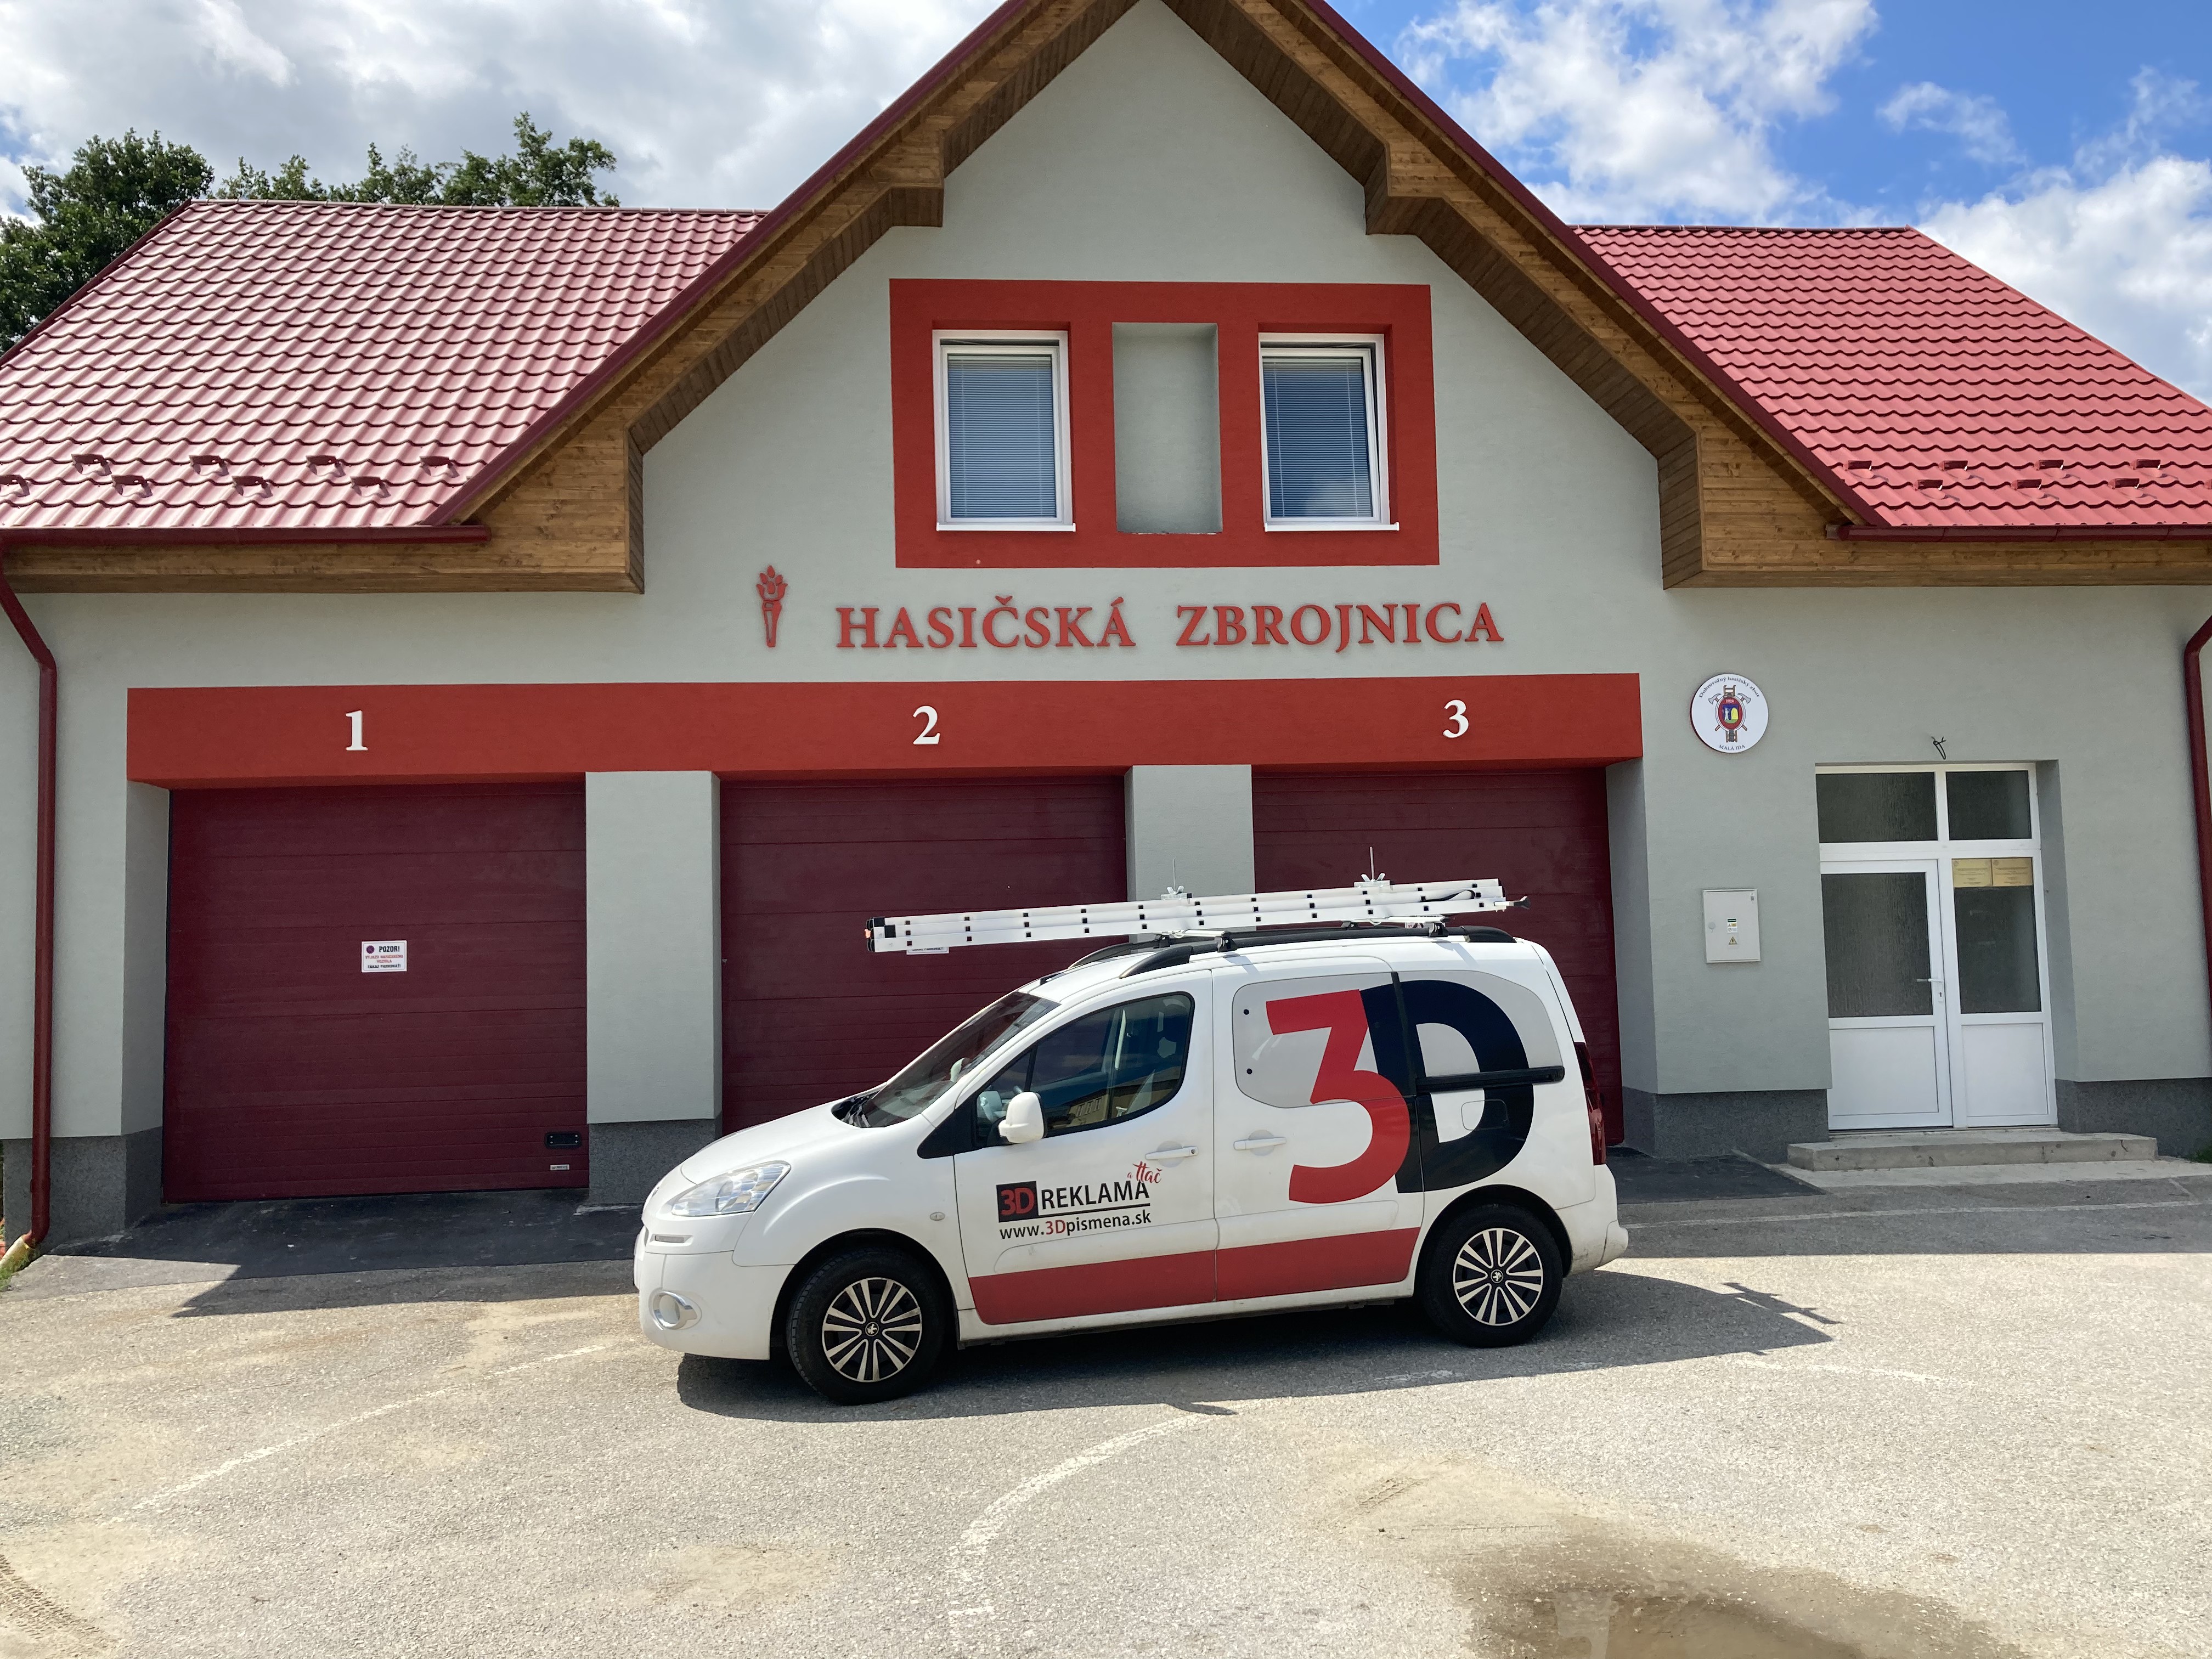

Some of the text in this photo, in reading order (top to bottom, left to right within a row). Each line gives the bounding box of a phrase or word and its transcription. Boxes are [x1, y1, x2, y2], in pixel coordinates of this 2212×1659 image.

[835, 595, 1504, 653] HASIČSKÁ ZBROJNICA
[1750, 686, 1760, 697] zbor
[345, 710, 368, 751] 1
[912, 705, 941, 745] 2
[1442, 698, 1469, 738] 3
[1265, 979, 1534, 1204] 3D
[1000, 1180, 1150, 1216] 3D REKLAMA
[999, 1209, 1152, 1240] www.3Dpismena.sk
